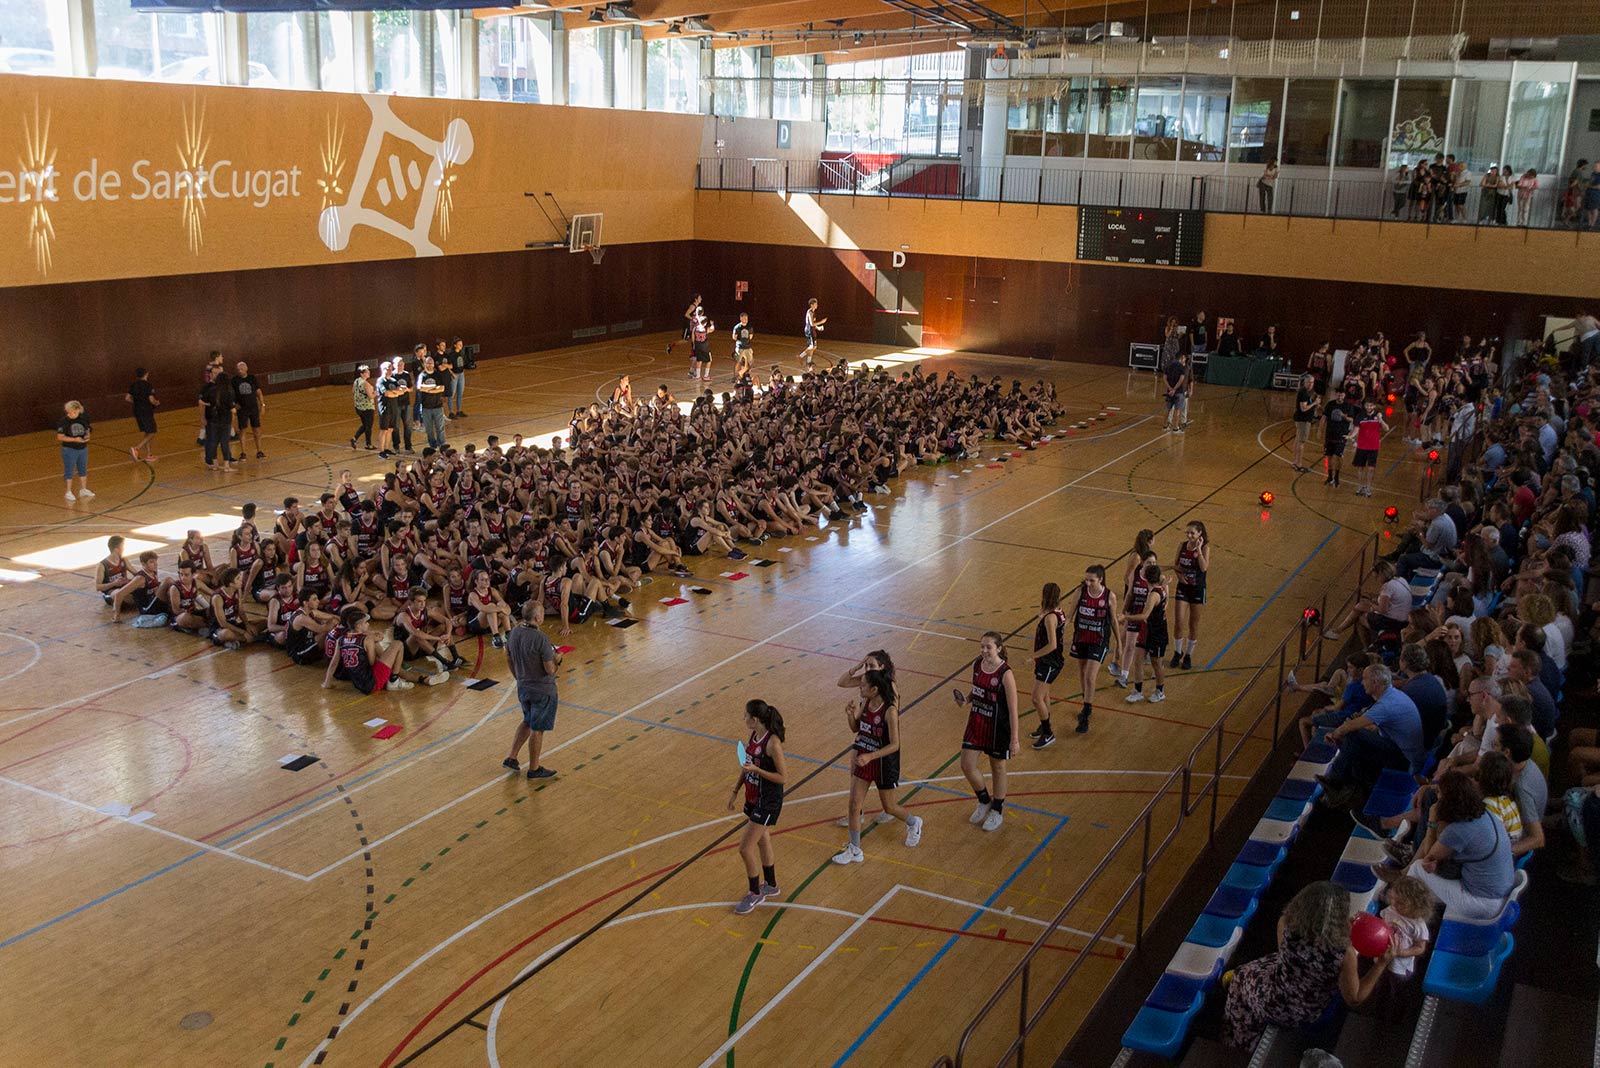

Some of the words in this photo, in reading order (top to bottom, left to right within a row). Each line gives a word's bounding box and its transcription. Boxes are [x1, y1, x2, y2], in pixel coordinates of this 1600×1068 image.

[780, 124, 790, 144] D
[73, 158, 121, 201] de
[1107, 223, 1127, 231] LOCAL
[892, 250, 906, 268] D
[341, 647, 360, 668] 23
